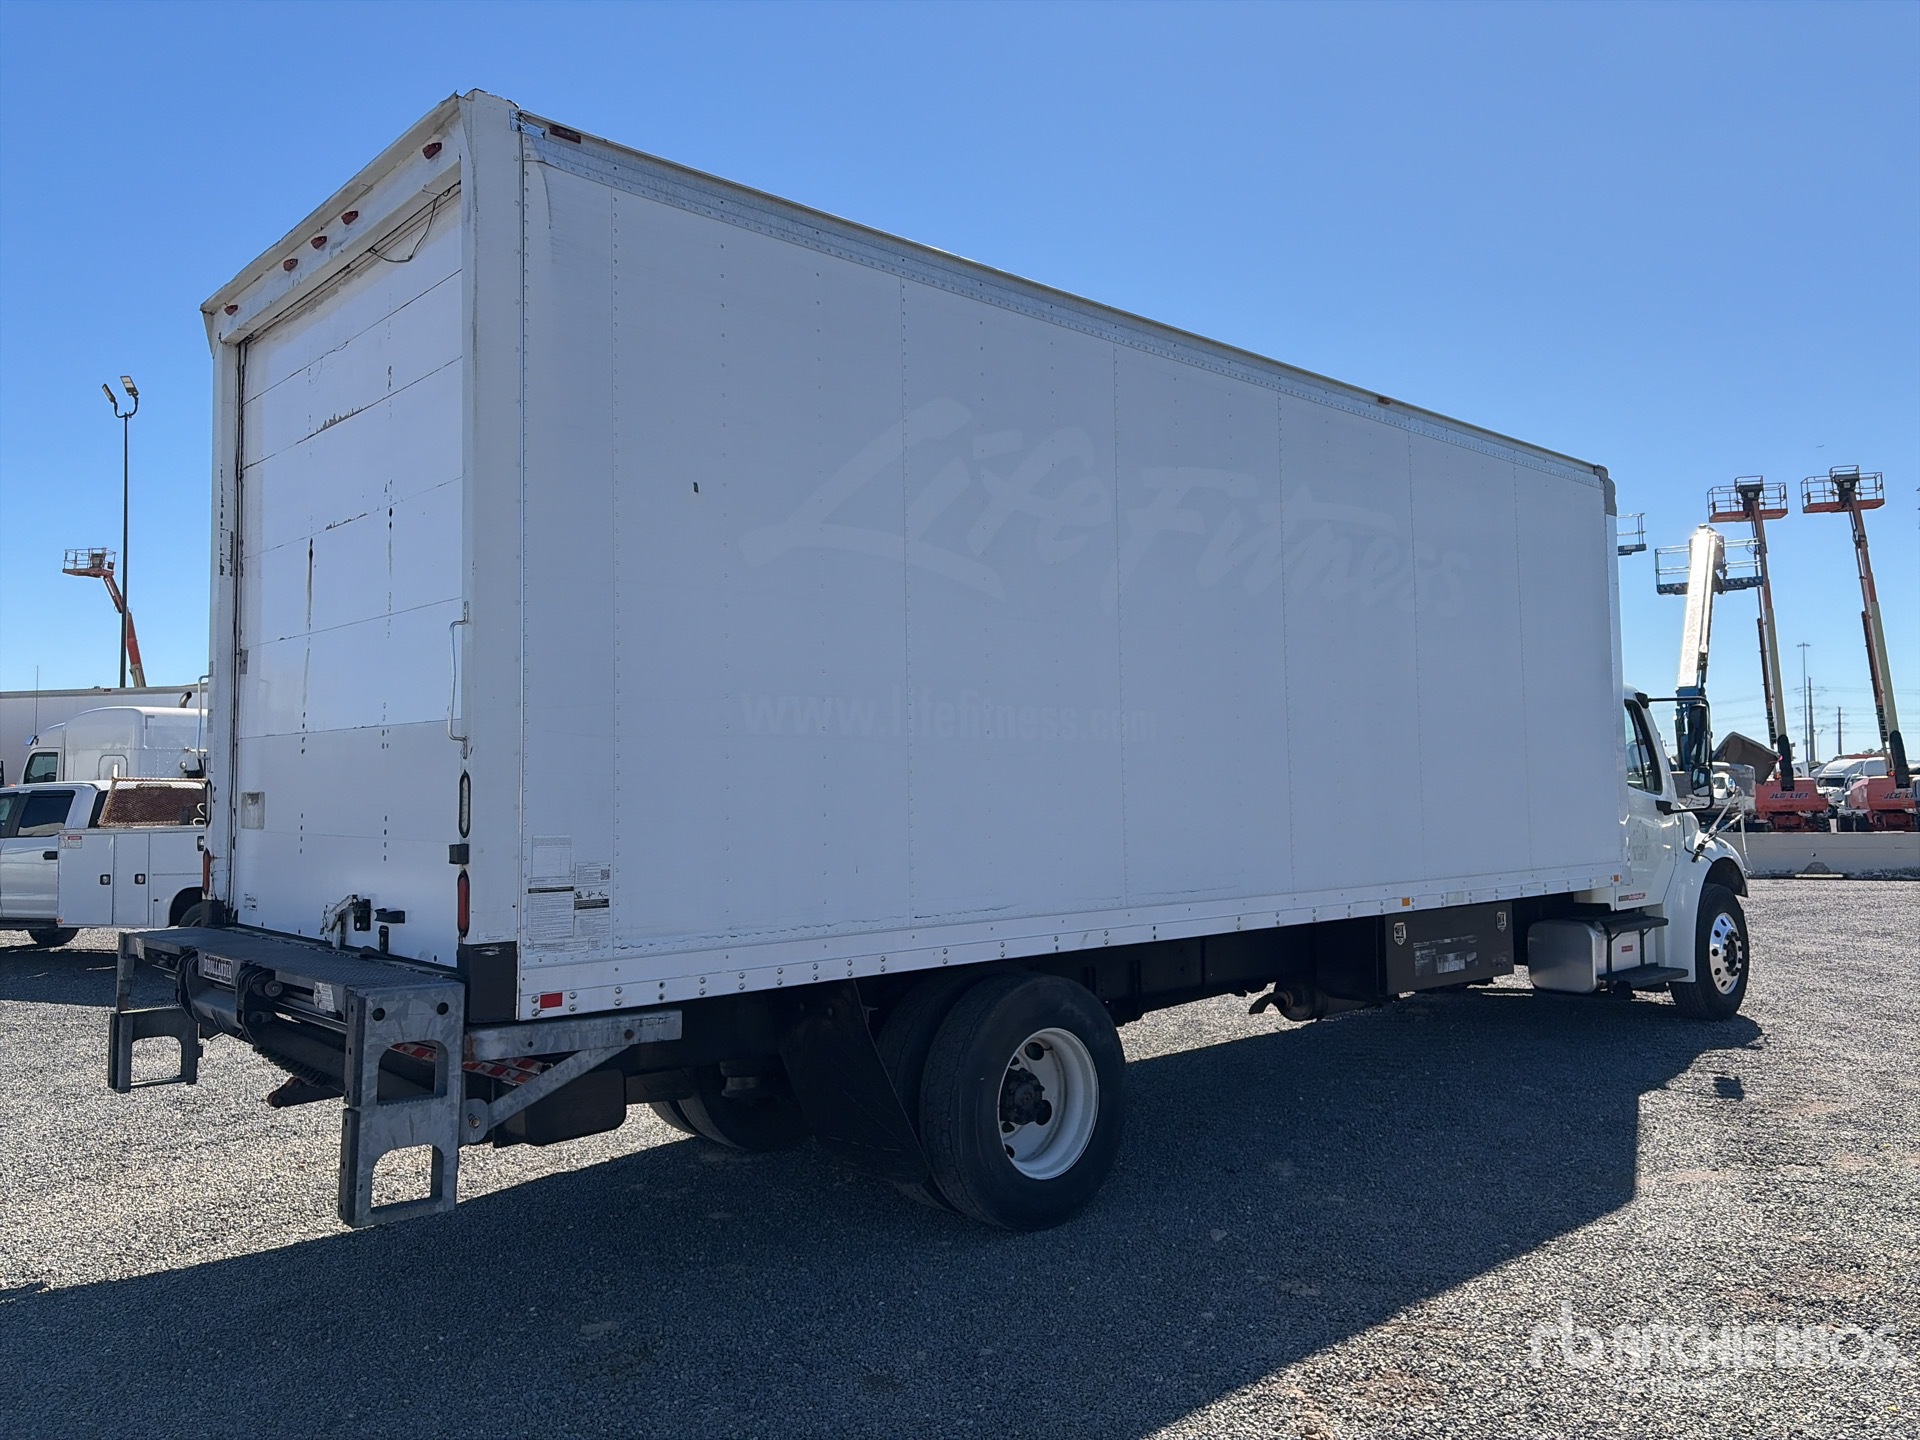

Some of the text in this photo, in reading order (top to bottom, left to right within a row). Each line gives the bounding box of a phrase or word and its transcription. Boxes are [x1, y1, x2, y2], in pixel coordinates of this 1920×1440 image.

[737, 396, 1472, 618] Life Fitness
[740, 684, 1158, 742] www.lifefitness.com
